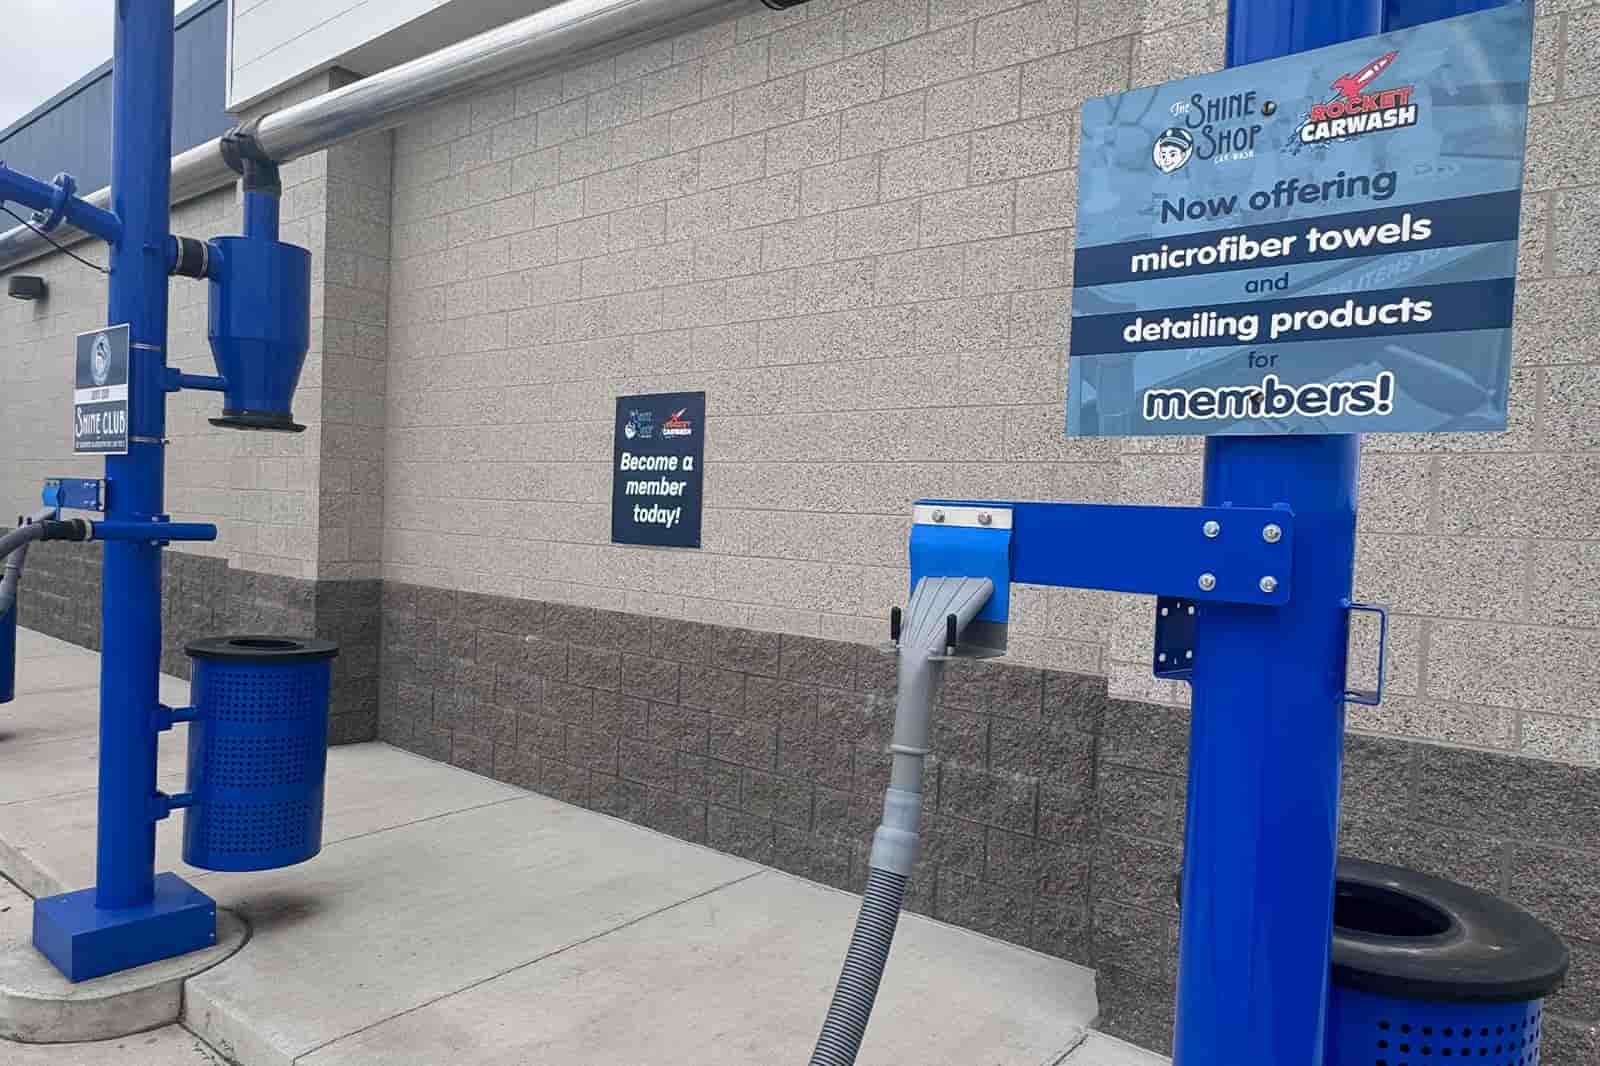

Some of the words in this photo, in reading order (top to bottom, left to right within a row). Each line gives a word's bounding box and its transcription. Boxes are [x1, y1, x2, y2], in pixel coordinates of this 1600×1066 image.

[1186, 91, 1256, 128] SHINE
[1311, 86, 1412, 121] ROCKET
[1301, 104, 1417, 142] CARWASH
[1197, 125, 1261, 160] SHOP
[1161, 195, 1237, 224] Now
[1250, 169, 1397, 210] offering
[1131, 234, 1297, 273] microfiber
[1306, 213, 1432, 253] towels
[1245, 272, 1289, 294] and
[1123, 312, 1259, 342] detailing
[1270, 298, 1432, 339] products
[1248, 351, 1279, 369] for
[1143, 371, 1394, 420] members!
[102, 410, 126, 434] CLUB
[620, 452, 678, 471] Become
[683, 455, 694, 471] a
[625, 477, 686, 496] member
[633, 504, 681, 528] today!
